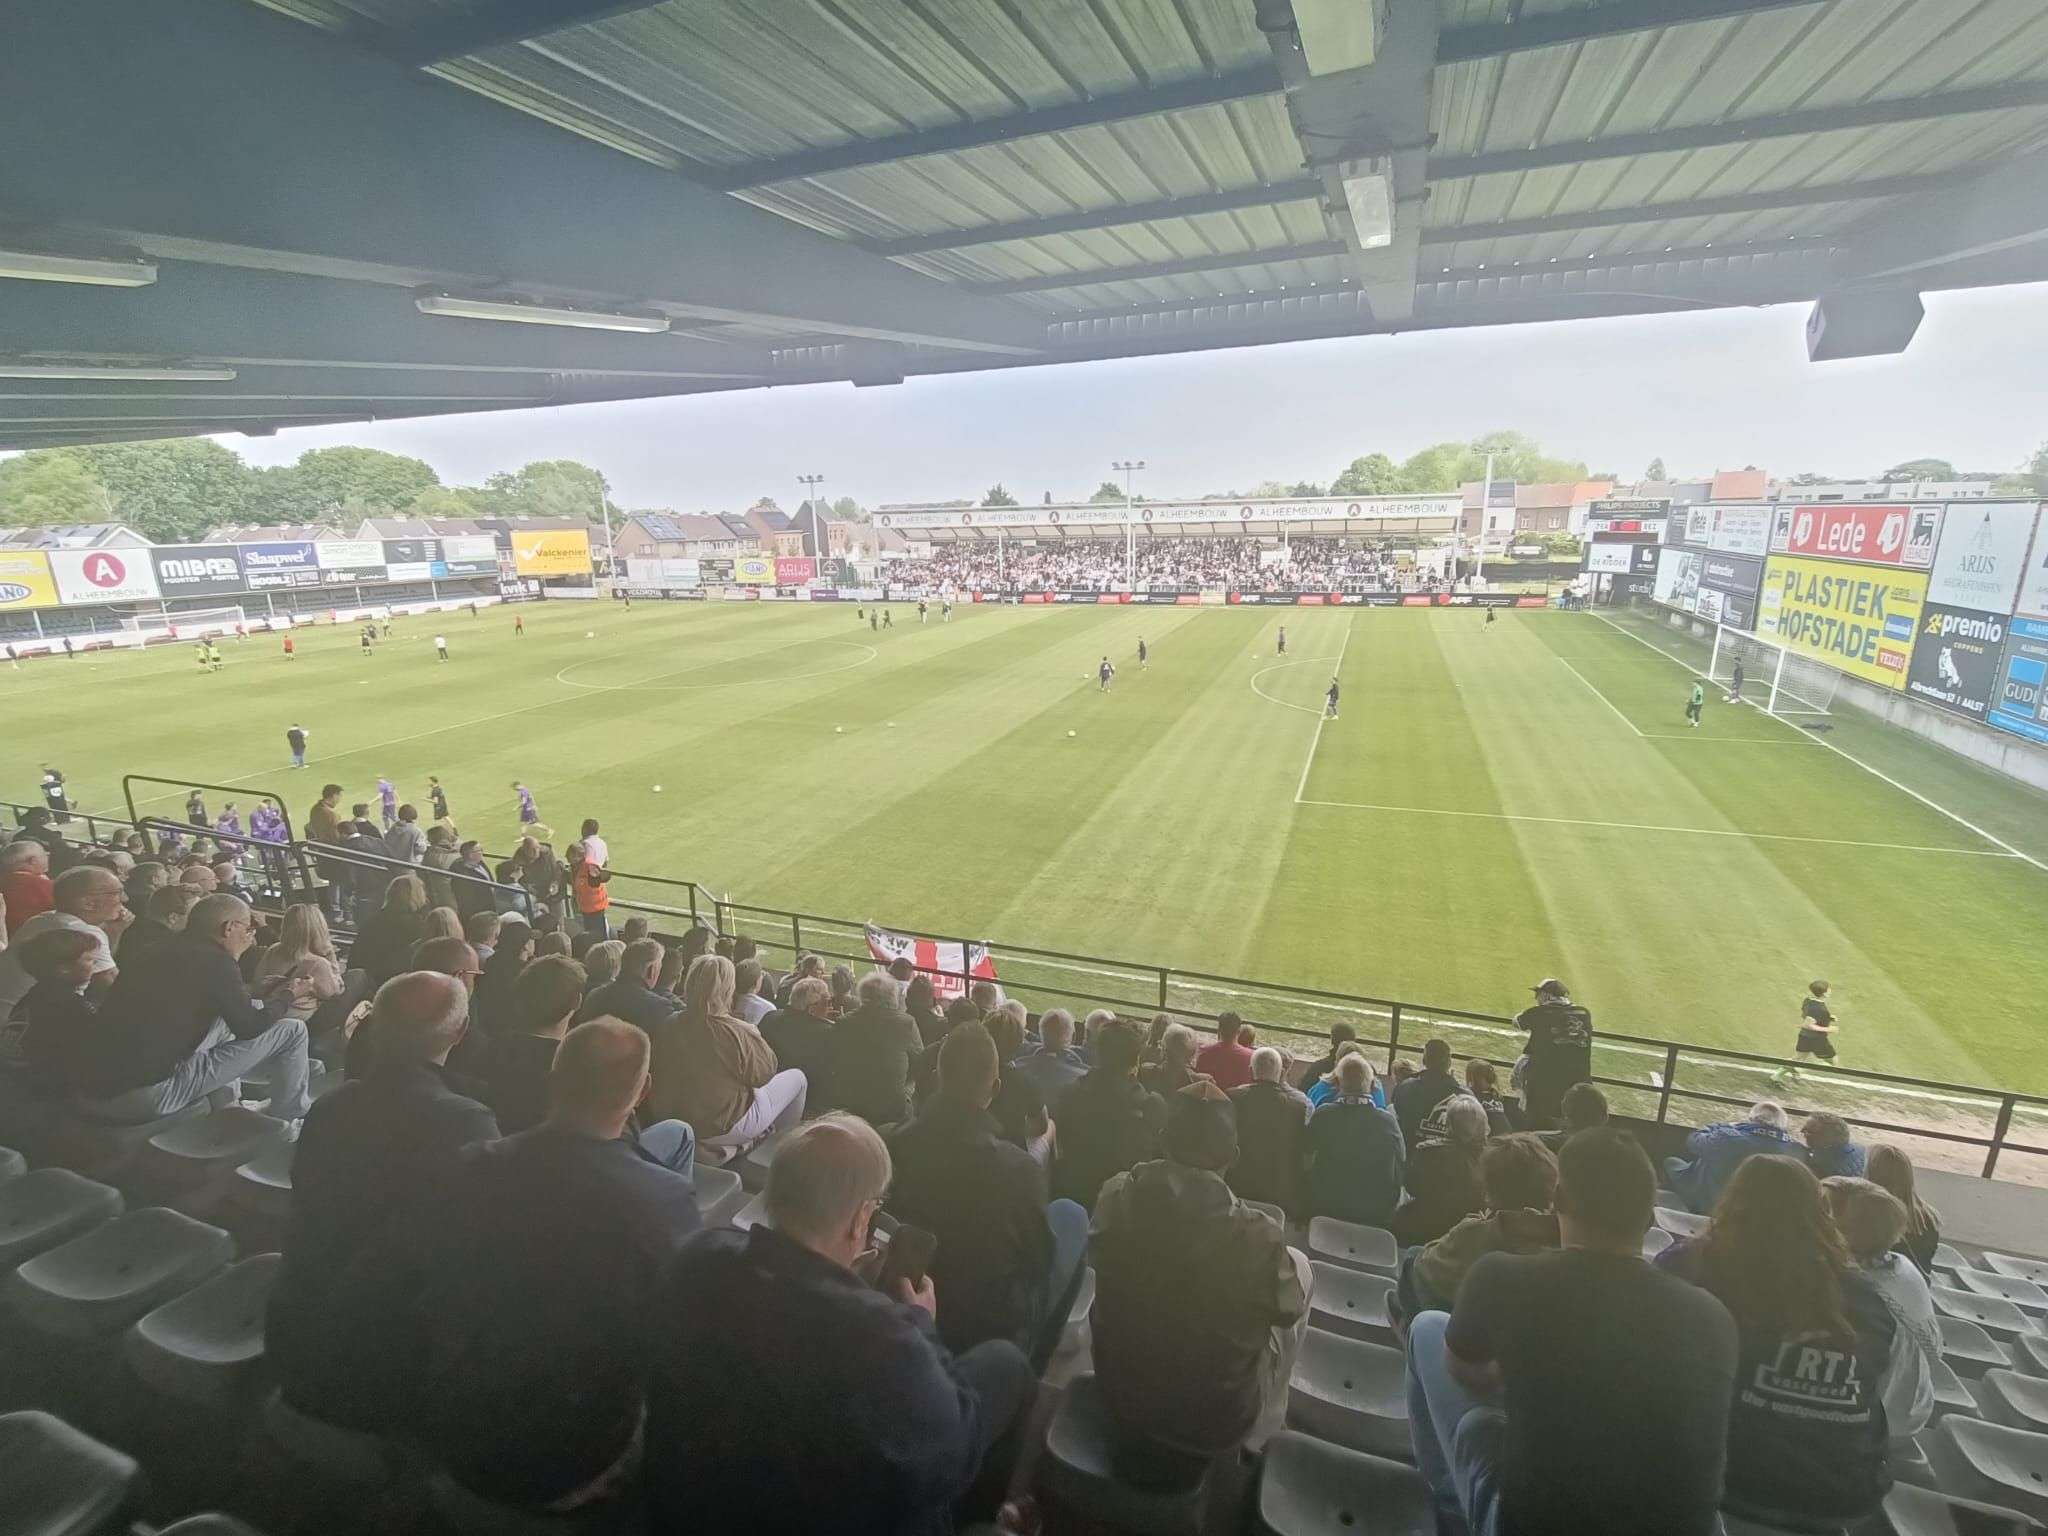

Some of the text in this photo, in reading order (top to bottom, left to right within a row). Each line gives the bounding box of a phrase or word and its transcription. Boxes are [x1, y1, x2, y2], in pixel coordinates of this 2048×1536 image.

[1159, 509, 1228, 519] ALHEEMBOUW
[1260, 506, 1334, 516] ALHEEMBOUW
[1368, 503, 1448, 514] ALHEEMBOUW
[977, 513, 1037, 523] ALHEEMBOUW
[1066, 511, 1129, 521] ALHEEMBOUW
[1817, 512, 1866, 553] Lede
[1958, 555, 1996, 574] ARIJS
[72, 588, 150, 600] ALHEEMBOUW
[500, 581, 528, 595] kvik
[1783, 570, 1889, 620] PLASTIEK
[1777, 607, 1880, 664] HOFSTADE
[1941, 615, 2002, 642] premio
[1961, 698, 1985, 713] AALST
[1771, 1376, 1848, 1398] vastgoed
